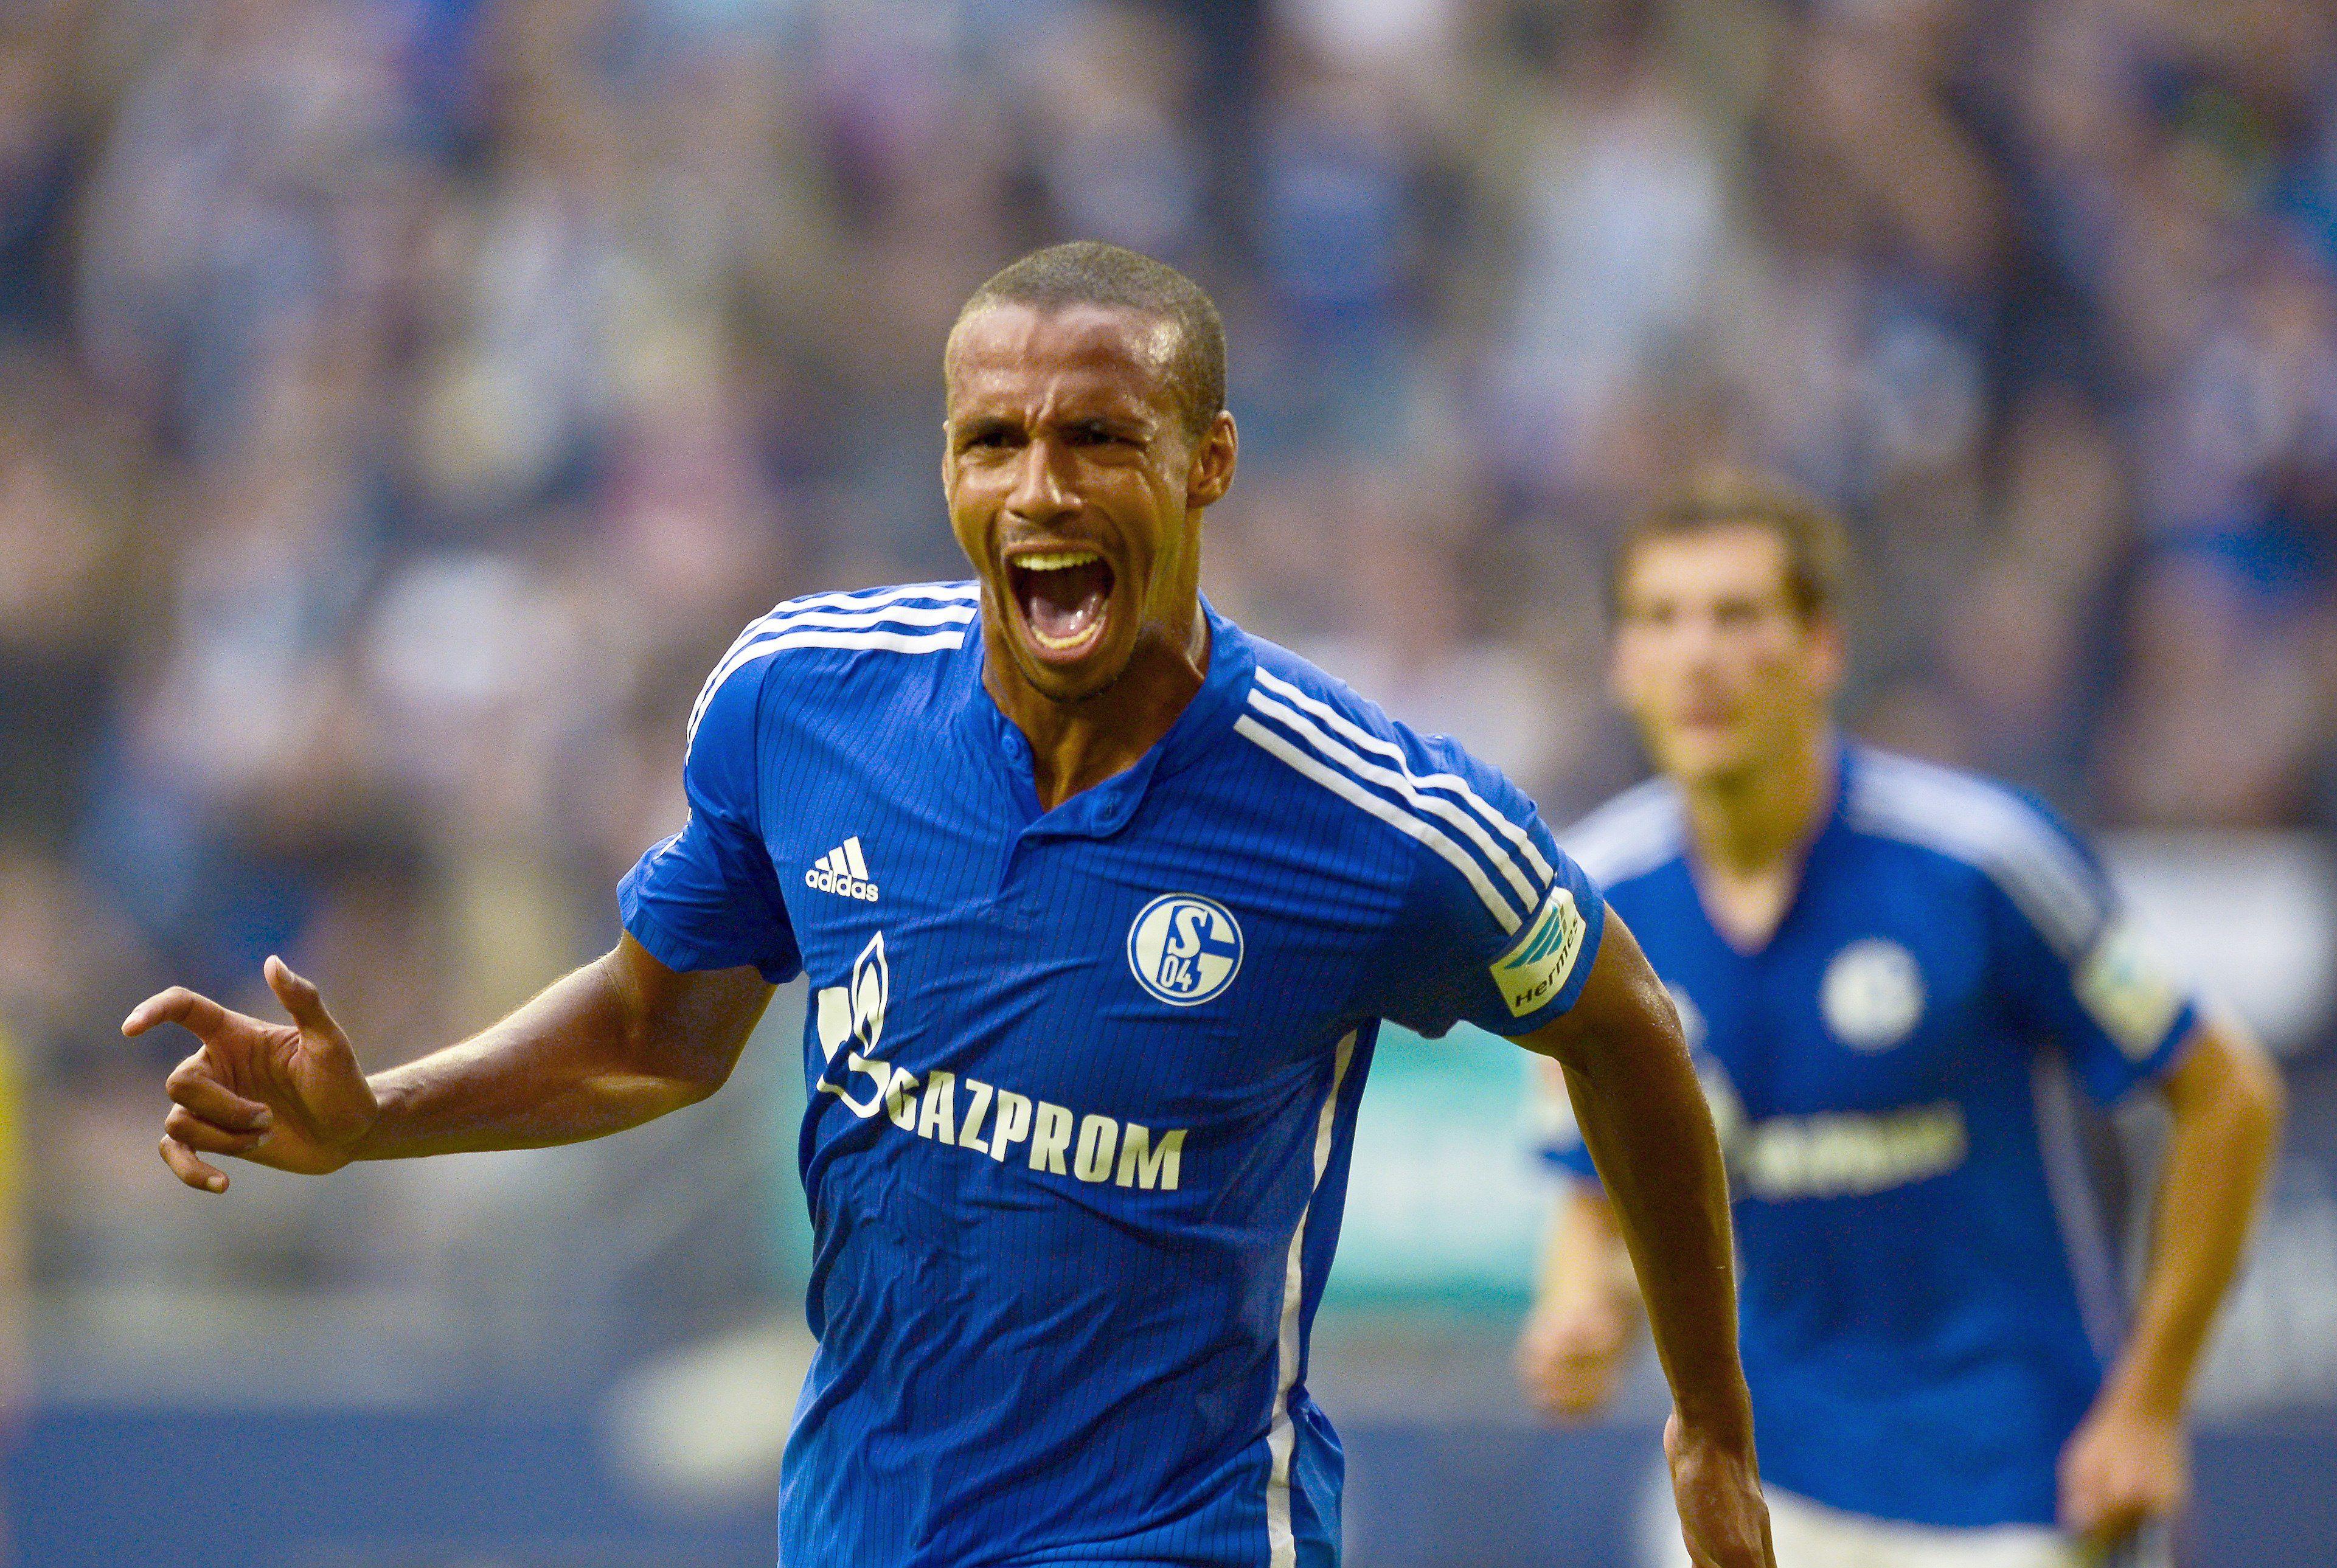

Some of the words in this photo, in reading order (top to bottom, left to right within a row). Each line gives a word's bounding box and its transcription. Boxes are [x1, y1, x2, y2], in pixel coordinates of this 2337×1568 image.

[805, 869, 879, 903] adidas
[1160, 954, 1193, 992] 04
[1515, 917, 1578, 1007] Hermes
[884, 1066, 1188, 1190] GAZPROM
